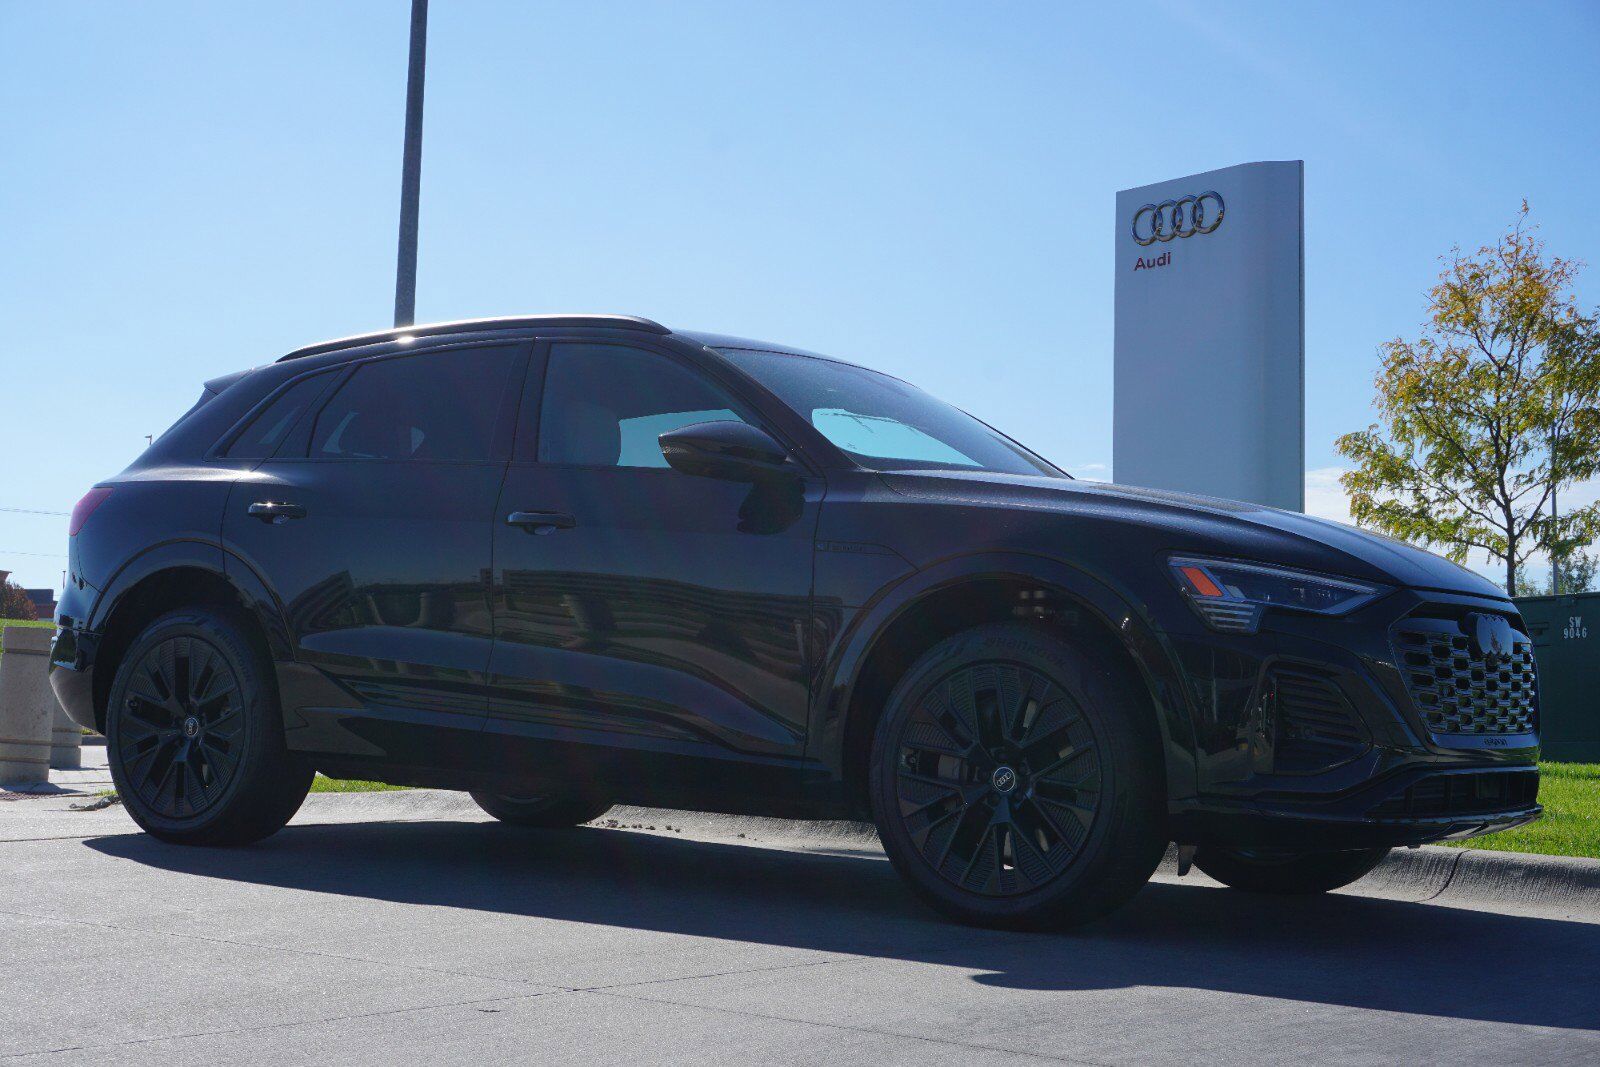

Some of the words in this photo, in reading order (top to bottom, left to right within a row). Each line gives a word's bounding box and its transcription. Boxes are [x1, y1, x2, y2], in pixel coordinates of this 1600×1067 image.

[1133, 251, 1171, 271] Audi
[1569, 616, 1582, 628] SW
[1563, 627, 1587, 639] 9046
